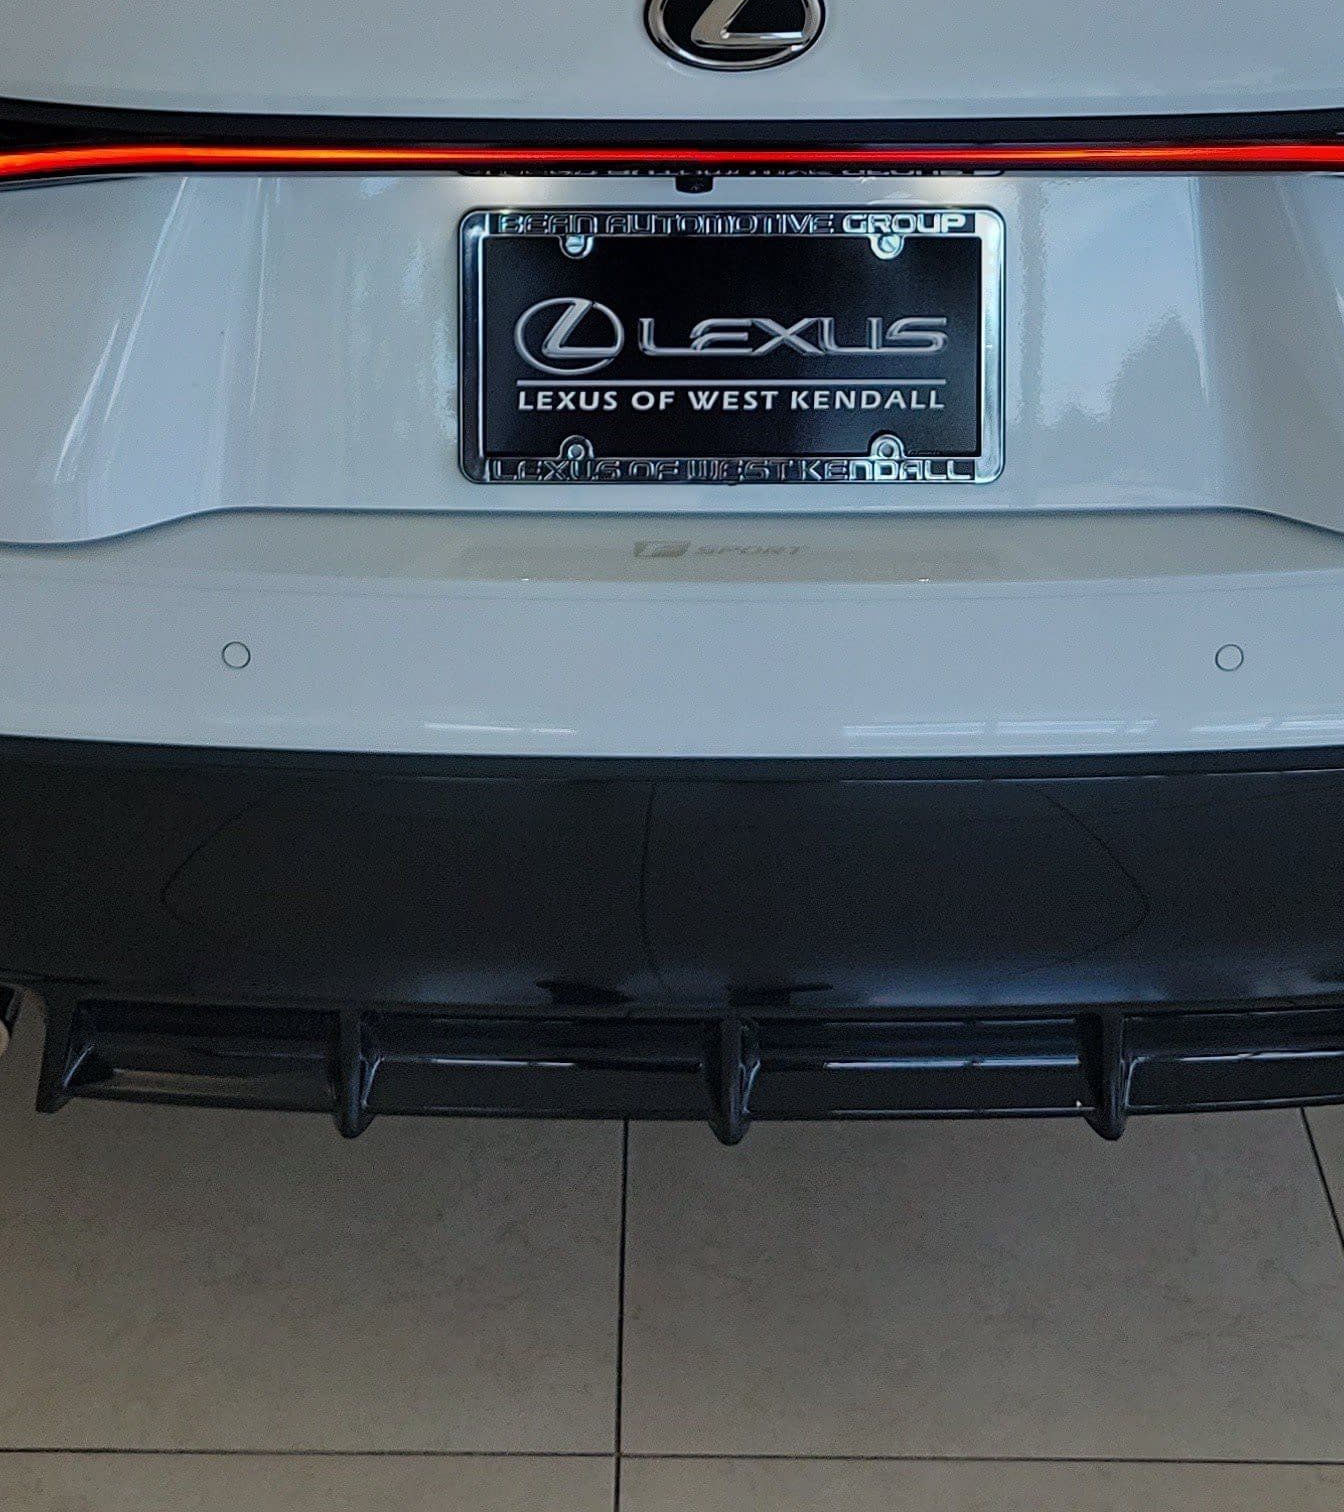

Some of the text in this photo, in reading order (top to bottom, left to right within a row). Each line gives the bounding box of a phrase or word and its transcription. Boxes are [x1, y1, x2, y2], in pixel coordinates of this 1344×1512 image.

[498, 213, 967, 234] BEAN AUTOMOTIVE GROUP
[638, 318, 948, 356] LEXUS
[518, 390, 945, 410] LEXUS OF WEST KENDALL
[493, 460, 971, 481] LEXUS OF WEST KENDALL
